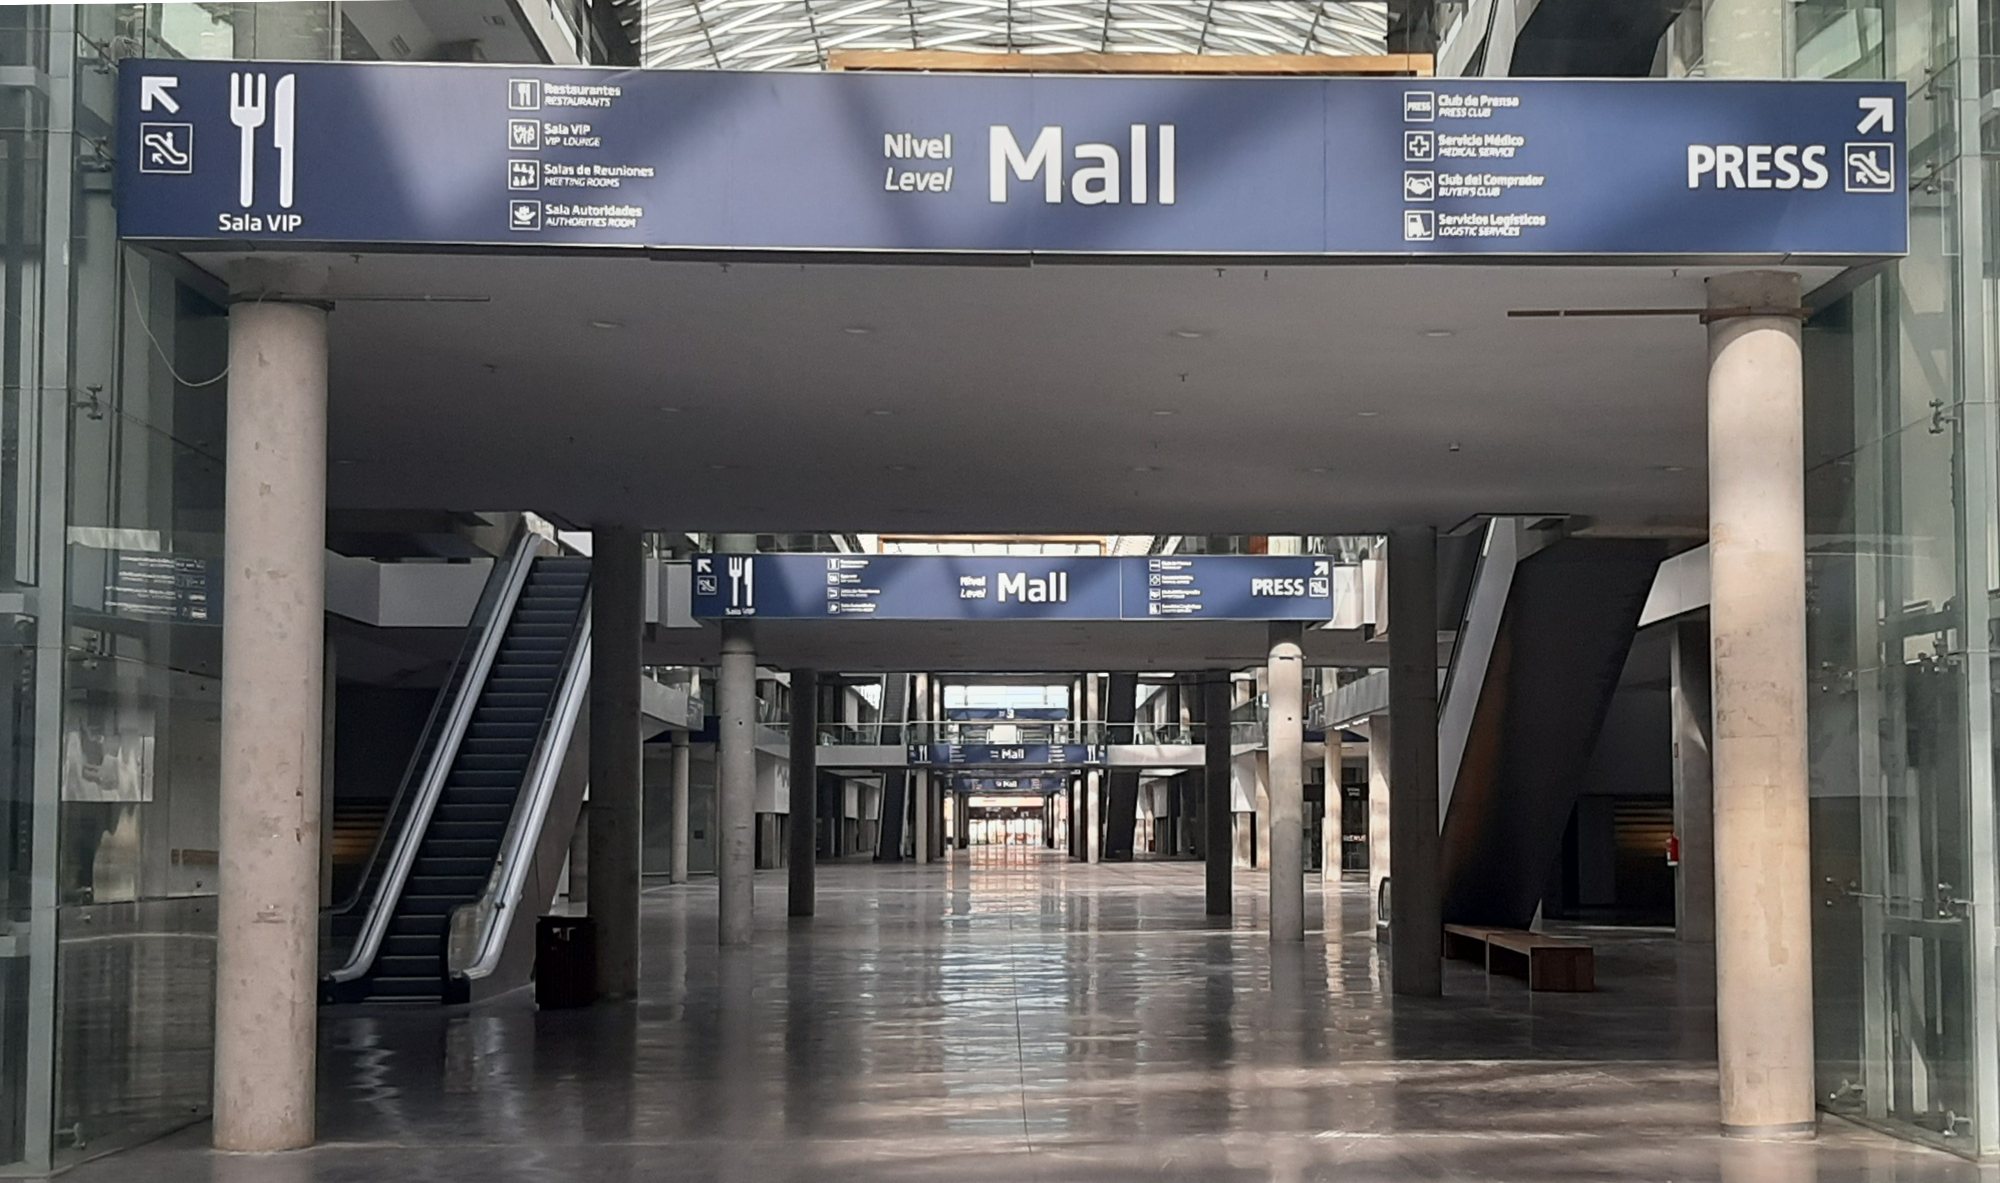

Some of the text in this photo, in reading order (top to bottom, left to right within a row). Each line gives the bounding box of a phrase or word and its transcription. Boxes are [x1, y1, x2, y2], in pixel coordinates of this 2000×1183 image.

[544, 83, 622, 96] Restaurantes
[544, 96, 612, 107] RESTAURANTS
[1407, 101, 1431, 111] PRESS
[1438, 94, 1520, 107] Club de Prensa
[1439, 107, 1492, 118] PRESS CLUB
[543, 123, 592, 136] Sala VIP
[544, 136, 602, 147] VIP LOUNGE
[884, 133, 952, 159] Nivel
[1438, 134, 1525, 147] Servicio Médico
[1438, 147, 1515, 158] MEDICAL SERVICE
[543, 163, 655, 177] Salas de Reuniones
[989, 124, 1176, 205] Mall
[1687, 144, 1829, 189] PRESS
[544, 176, 620, 188] MEETING ROOMS
[884, 166, 953, 192] Level
[1438, 174, 1545, 189] Club del Comprador
[1476, 187, 1501, 197] CLUB
[545, 204, 643, 217] Sala Autoridades
[218, 213, 303, 232] Sala VIP
[545, 217, 637, 228] AUTHORITIES ROOM
[1438, 213, 1489, 225] Servicios
[1438, 227, 1521, 237] LOGISTIC SERVICES
[998, 572, 1067, 603] Mall
[1251, 578, 1305, 597] PRESS
[1001, 748, 1025, 760] Mall
